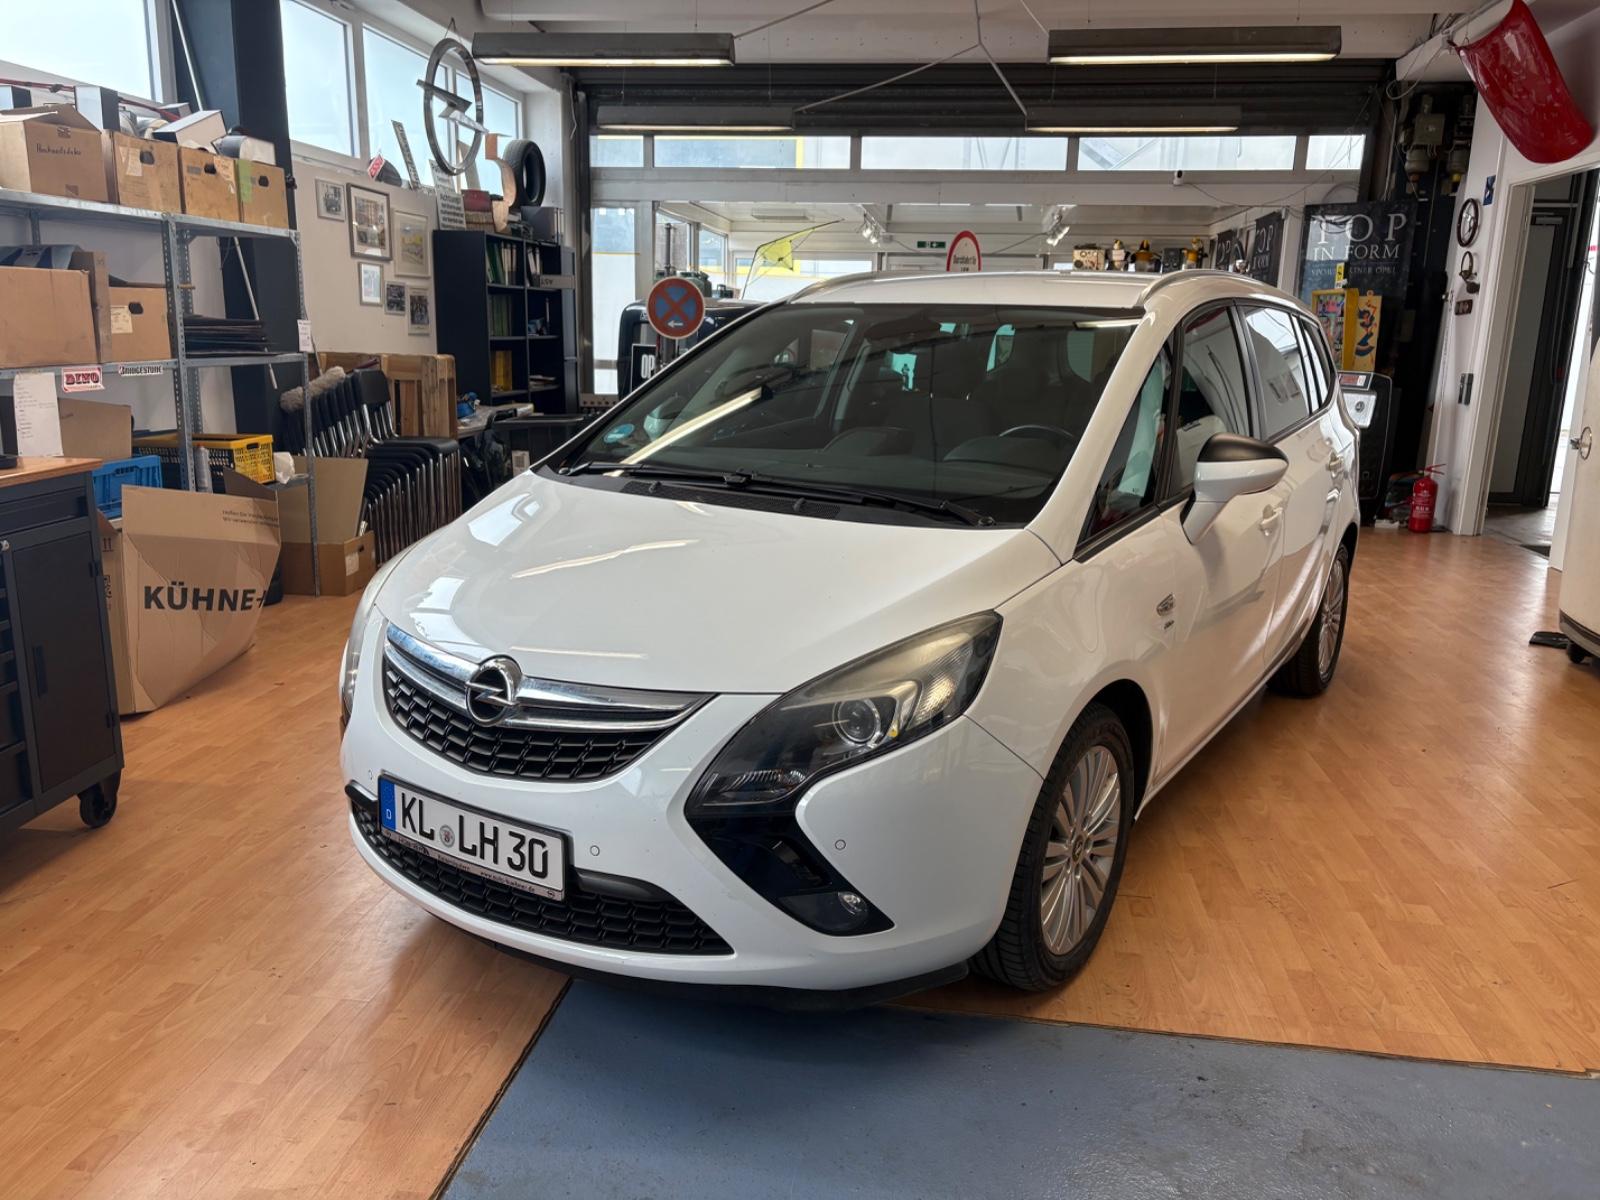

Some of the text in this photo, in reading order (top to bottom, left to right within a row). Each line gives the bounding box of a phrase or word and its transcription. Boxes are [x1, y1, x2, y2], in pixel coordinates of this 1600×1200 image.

[1313, 244, 1400, 261] IN FORM
[641, 353, 656, 379] OP
[386, 809, 391, 820] D
[401, 792, 435, 841] KL
[458, 814, 499, 865] LH
[507, 830, 548, 879] 30
